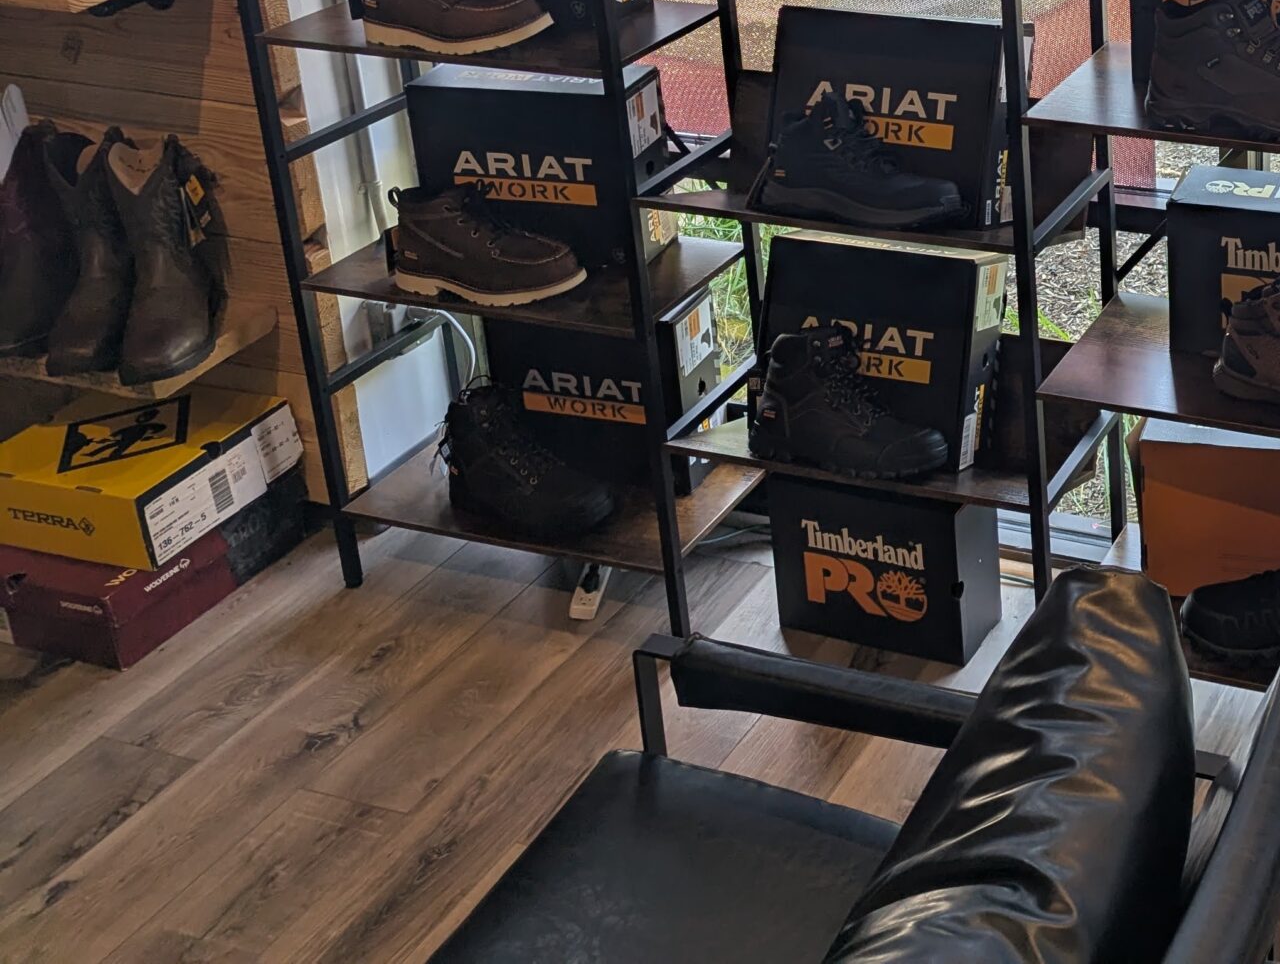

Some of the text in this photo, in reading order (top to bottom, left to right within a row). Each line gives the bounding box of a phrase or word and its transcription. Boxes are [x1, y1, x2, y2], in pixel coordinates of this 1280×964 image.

[864, 119, 926, 144] ORK
[453, 150, 592, 181] ARIAT
[486, 179, 572, 202] WORK
[523, 368, 642, 403] ARIAT
[547, 396, 628, 420] WORK
[801, 519, 924, 571] Timberland
